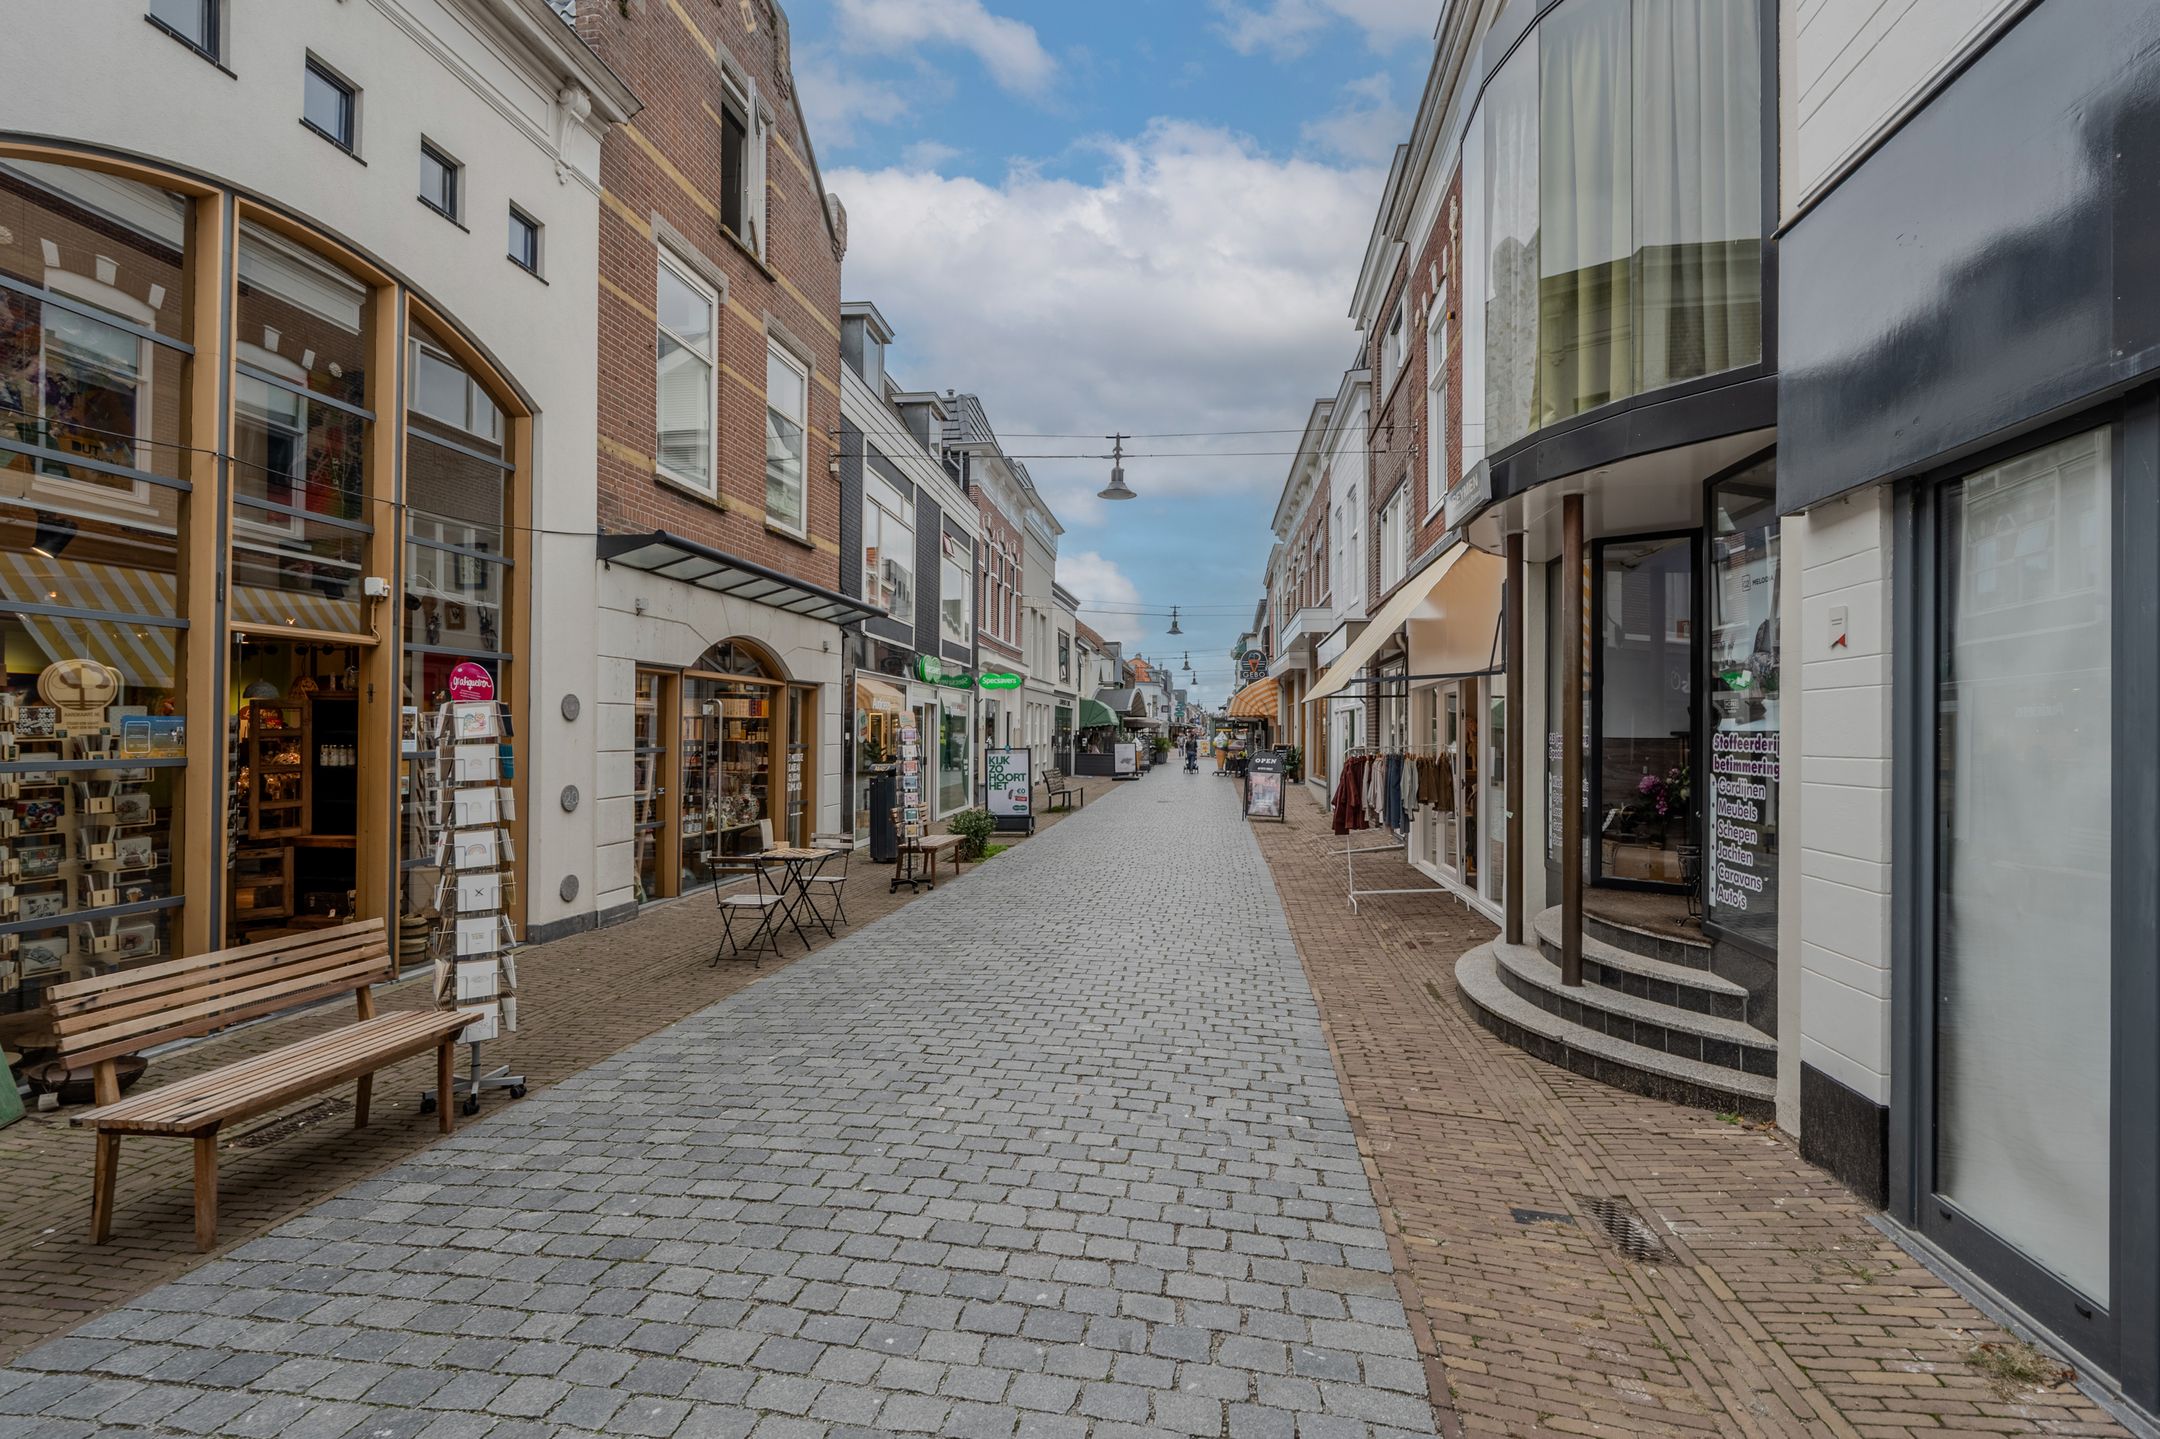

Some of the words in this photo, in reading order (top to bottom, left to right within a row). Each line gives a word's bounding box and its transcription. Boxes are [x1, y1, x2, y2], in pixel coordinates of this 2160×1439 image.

[982, 676, 1017, 685] Specsavers
[988, 756, 1010, 765] KIJK
[988, 765, 1004, 773] ZO
[988, 773, 1026, 782] HOORT
[988, 781, 1009, 790] HET
[1718, 777, 1766, 800] Gordijnen
[1718, 798, 1758, 821] Meubels
[1717, 819, 1757, 845] Schepen
[1717, 841, 1753, 867] Jachten
[1717, 862, 1763, 892] Caravans
[1717, 884, 1747, 910] Auto's
